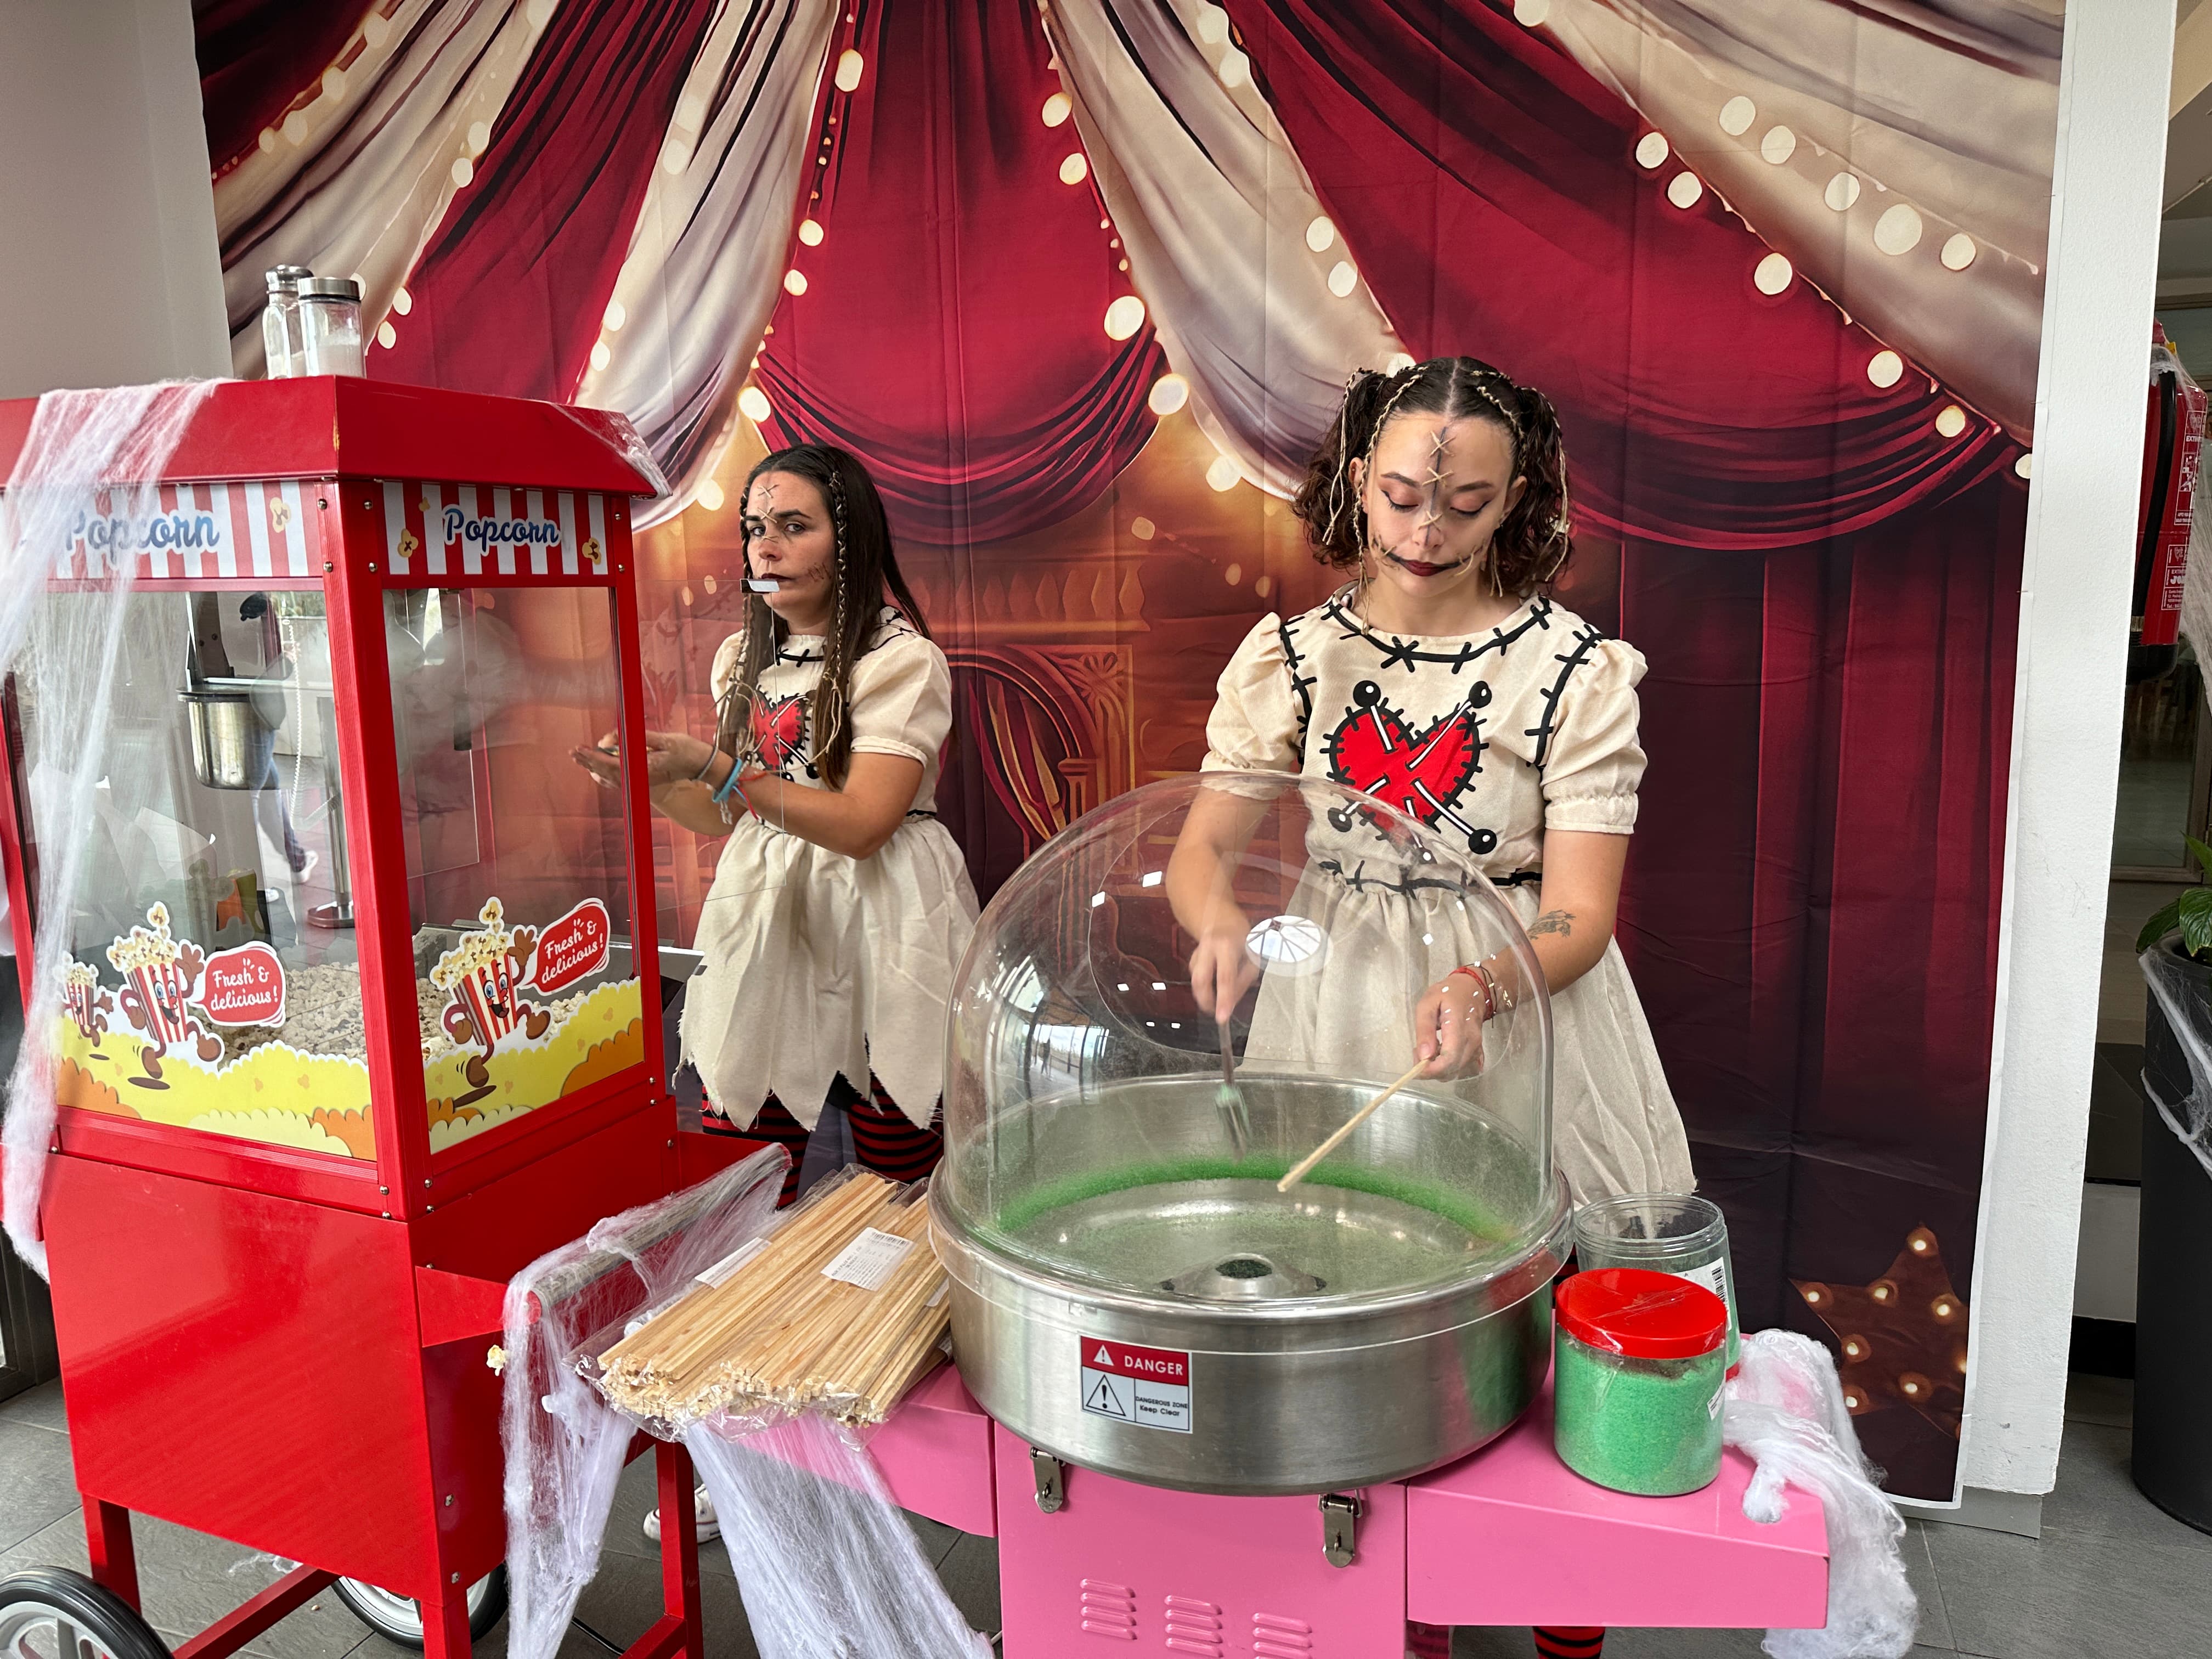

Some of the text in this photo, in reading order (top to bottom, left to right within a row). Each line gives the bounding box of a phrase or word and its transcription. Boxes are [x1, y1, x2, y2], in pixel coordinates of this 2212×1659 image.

[444, 508, 558, 552] Popcorn
[545, 920, 597, 960] Fresh &
[541, 933, 603, 984] delicious!
[212, 966, 269, 988] Fresh &
[211, 985, 278, 1011] delicious!
[1125, 1355, 1183, 1375] DANGER
[1136, 1396, 1170, 1406] DANGEROUS
[1140, 1405, 1157, 1414] Keep
